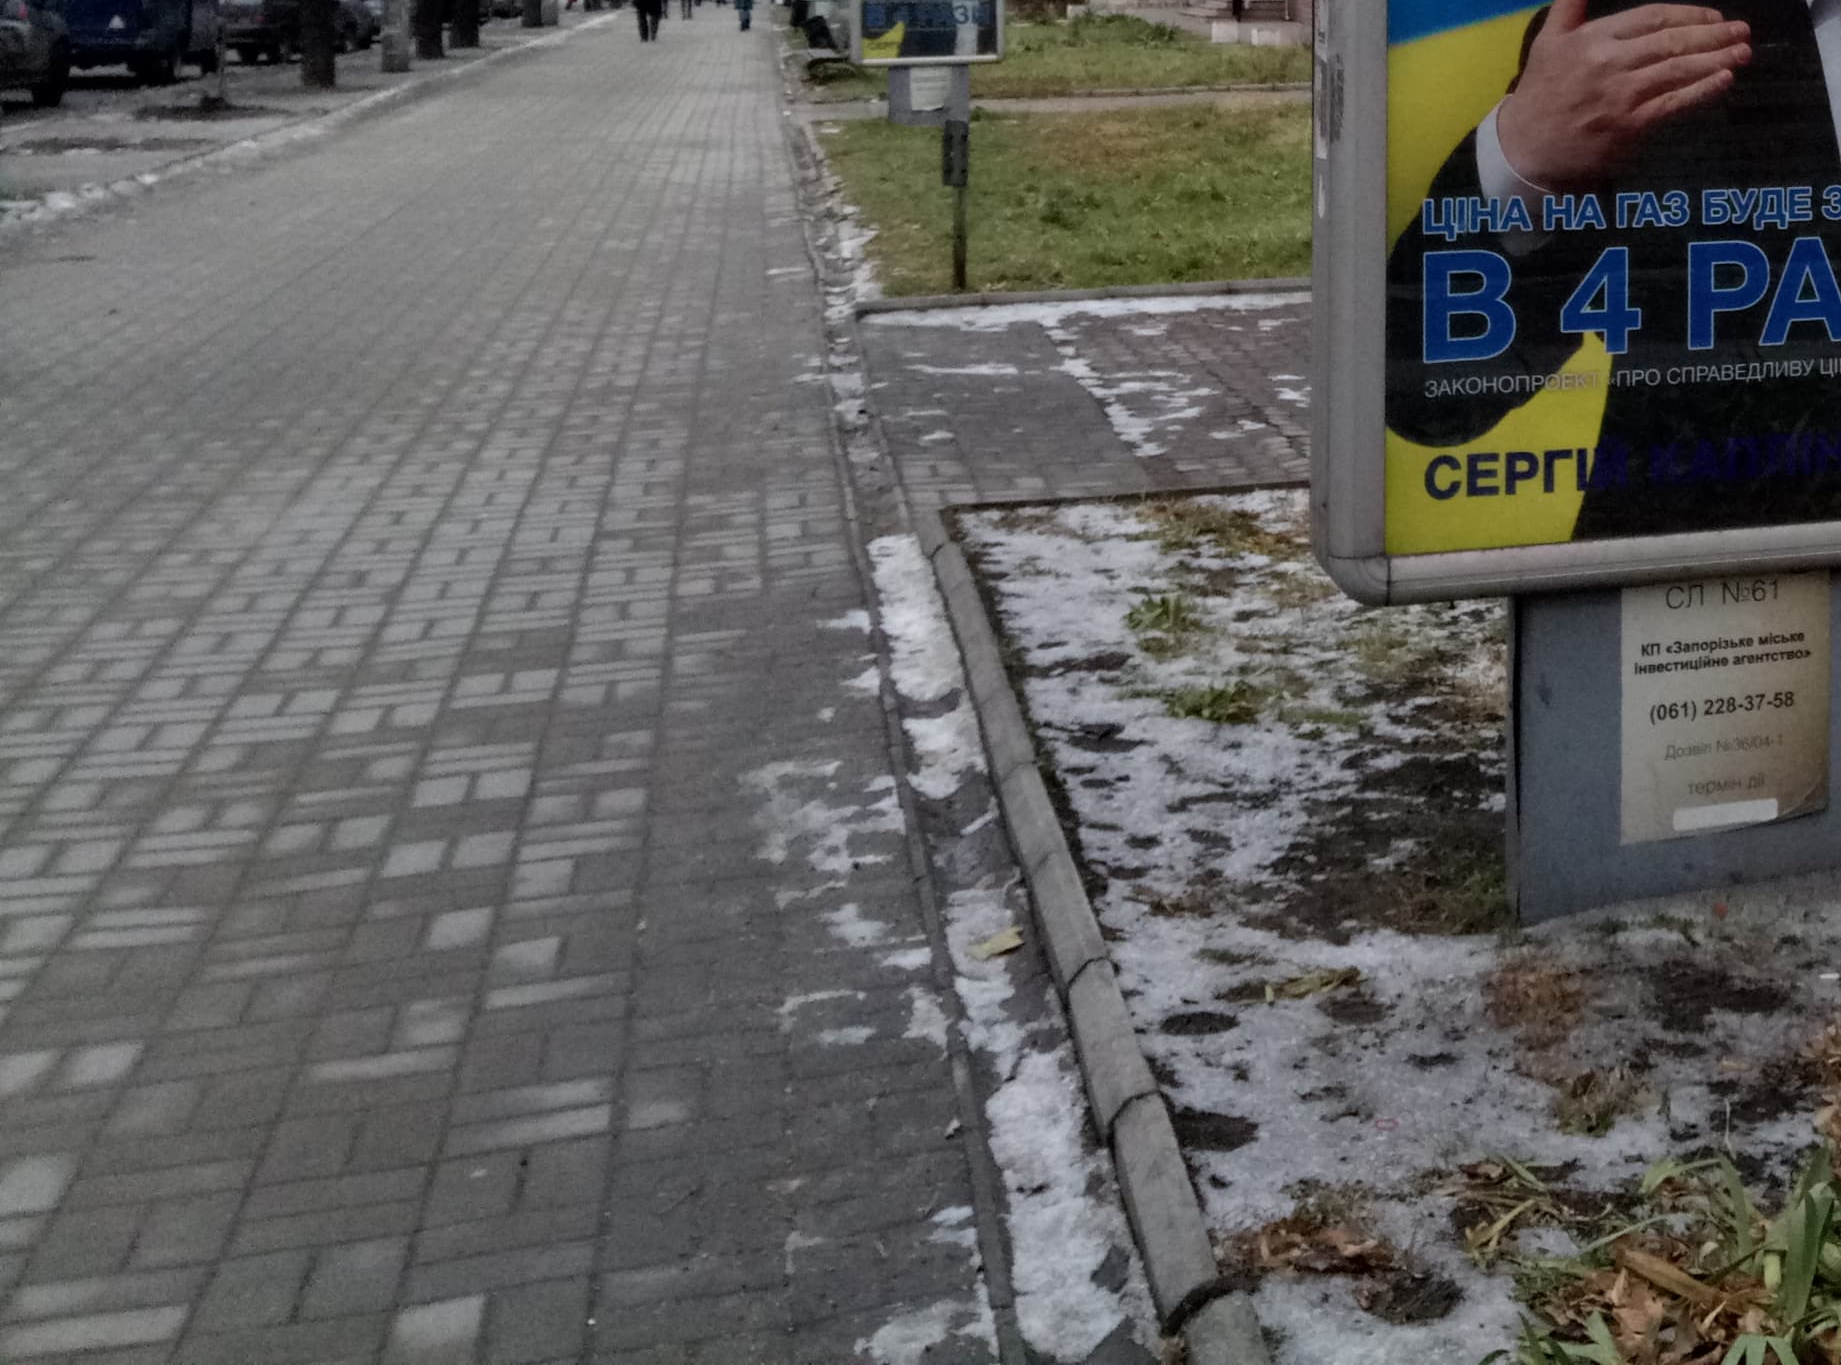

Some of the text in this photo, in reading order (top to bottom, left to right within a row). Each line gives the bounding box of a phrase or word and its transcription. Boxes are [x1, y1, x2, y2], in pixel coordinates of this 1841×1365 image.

[1423, 195, 1532, 240] ЦІНА
[1543, 192, 1607, 231] НА
[1615, 189, 1690, 228] ГАЗ
[1702, 185, 1812, 230] БУДЕ
[1422, 249, 1519, 364] В
[1560, 246, 1642, 355] 4
[1424, 369, 1601, 399] ЗАКОНОПРОЕКТ
[1606, 367, 1661, 389] «ПРО
[1666, 357, 1814, 387] СПРАВЕДЛИВУ
[1424, 435, 1629, 501] СЕРГІЙ
[1665, 578, 1779, 609] СЛ №61
[1634, 648, 1812, 675] інвестиційне агентство»
[1640, 631, 1806, 657] КП «Запорізьке міське
[1650, 690, 1795, 725] (061) 228-37-58
